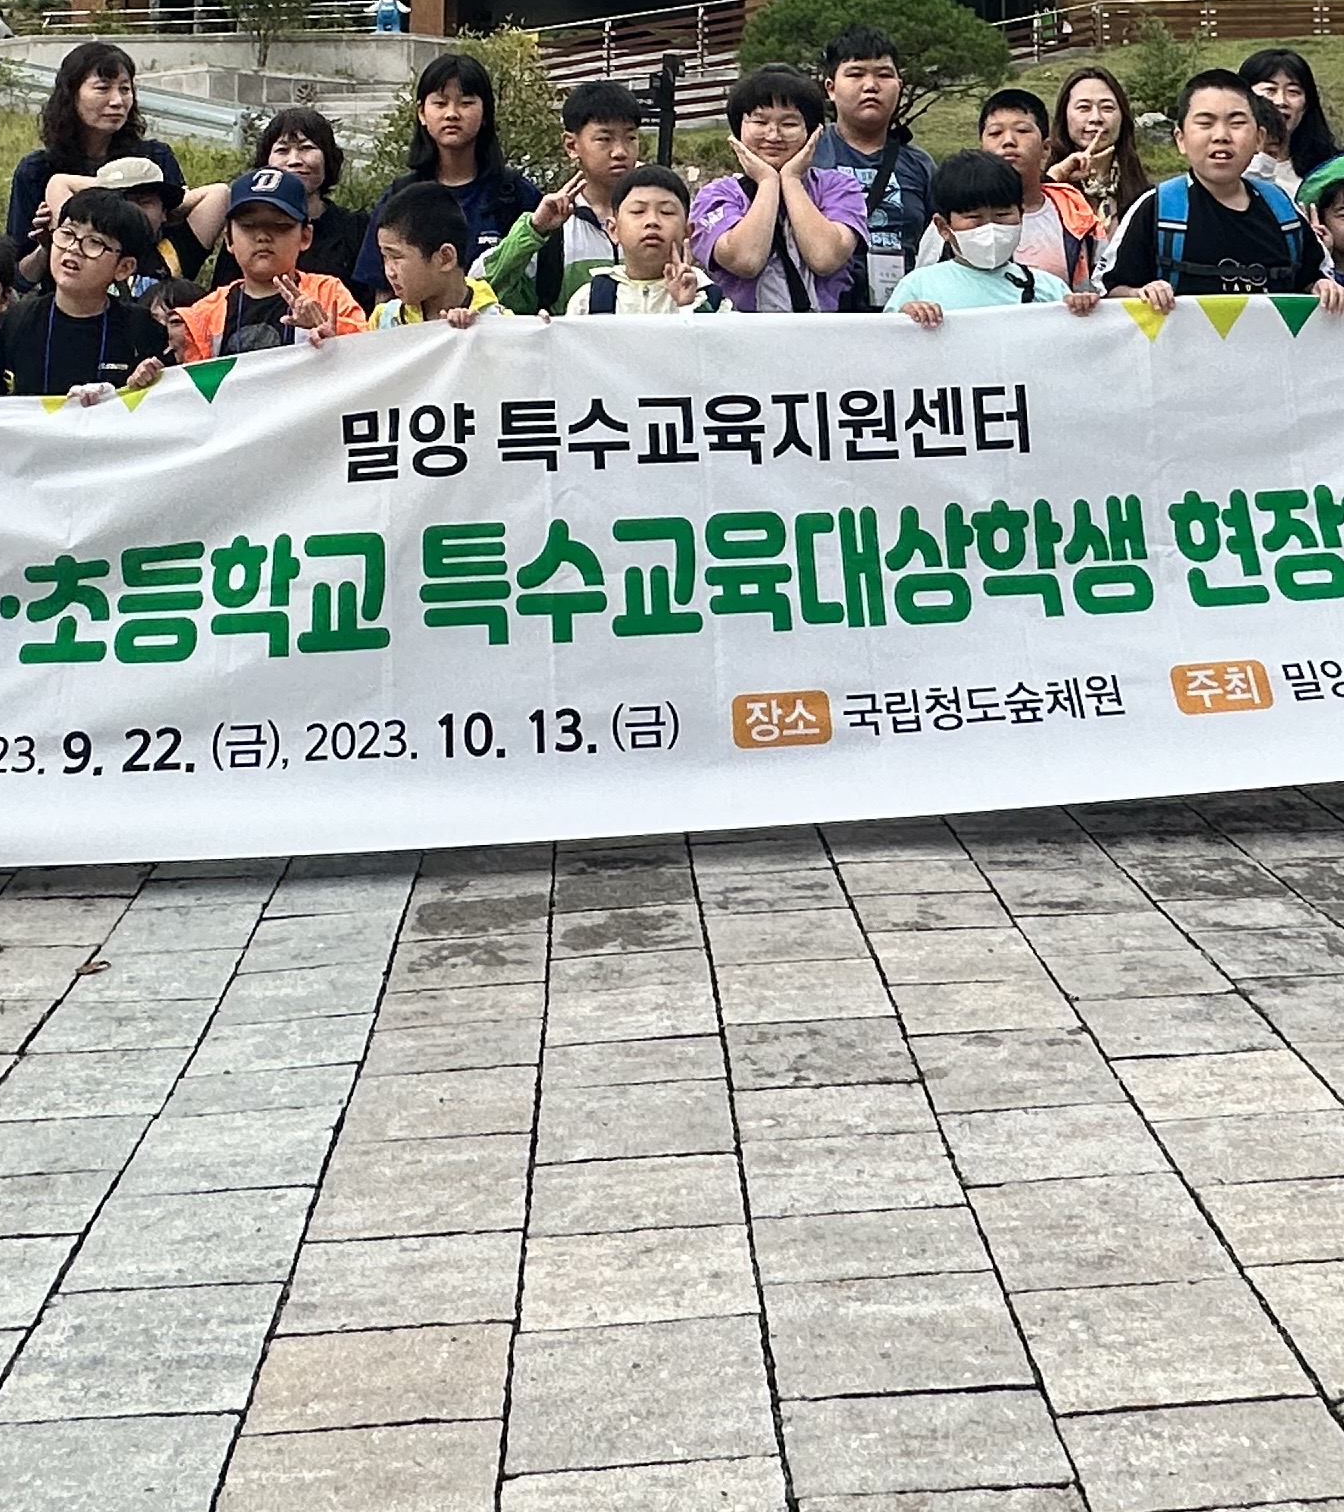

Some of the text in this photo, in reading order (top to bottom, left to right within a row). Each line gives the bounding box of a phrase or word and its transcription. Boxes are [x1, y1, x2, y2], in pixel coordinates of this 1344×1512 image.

[341, 384, 1030, 483] 밀양 특수교육지원센터
[419, 494, 1154, 645] 특수교육대상학생
[746, 674, 1126, 742] 장소 국립청도숲체원
[1184, 665, 1262, 709] 주최
[62, 730, 103, 777] 9.
[122, 726, 195, 773] 22.
[212, 719, 289, 772] (금),
[305, 719, 418, 762] 2023.
[438, 711, 506, 759] 10.
[528, 708, 597, 754] 13.
[612, 700, 679, 752] (금)
